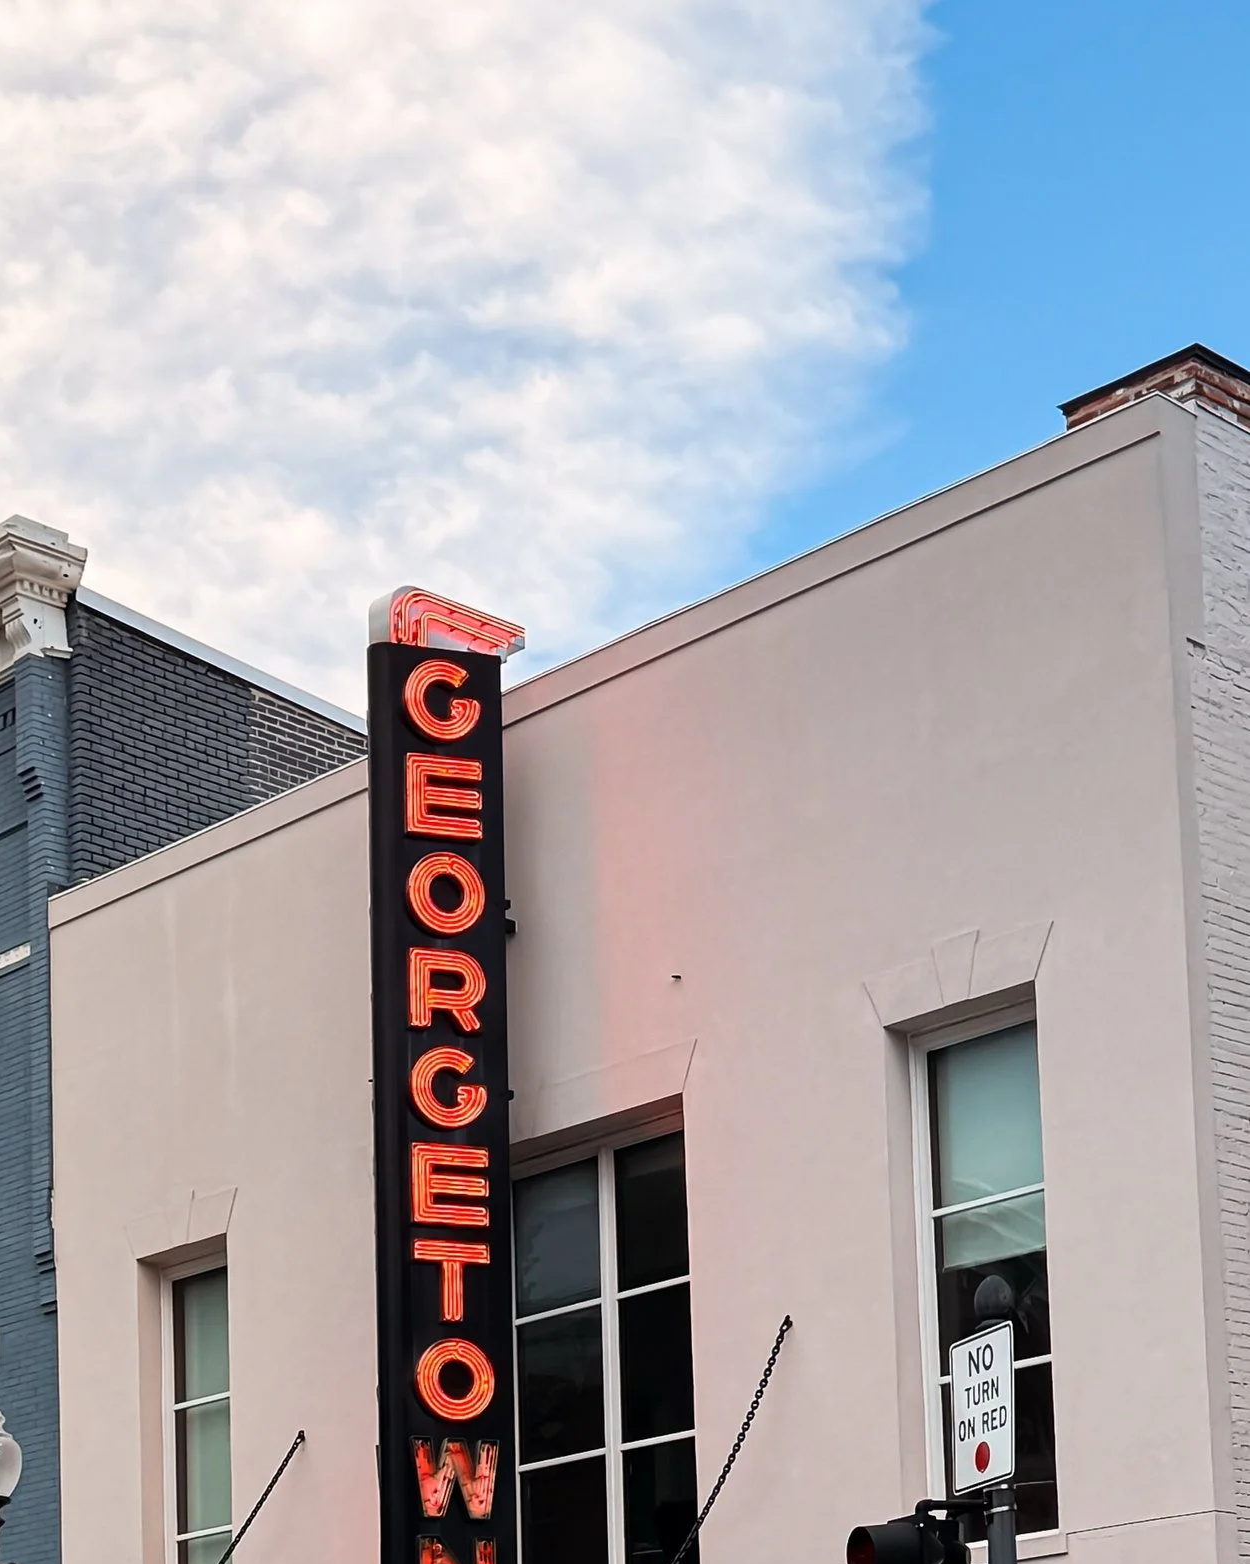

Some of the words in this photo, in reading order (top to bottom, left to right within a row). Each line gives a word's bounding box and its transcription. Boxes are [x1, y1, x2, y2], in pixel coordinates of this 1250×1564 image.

[968, 1343, 994, 1377] NO
[965, 1376, 999, 1409] TURN
[958, 1416, 976, 1442] ON
[981, 1405, 1007, 1434] RED
